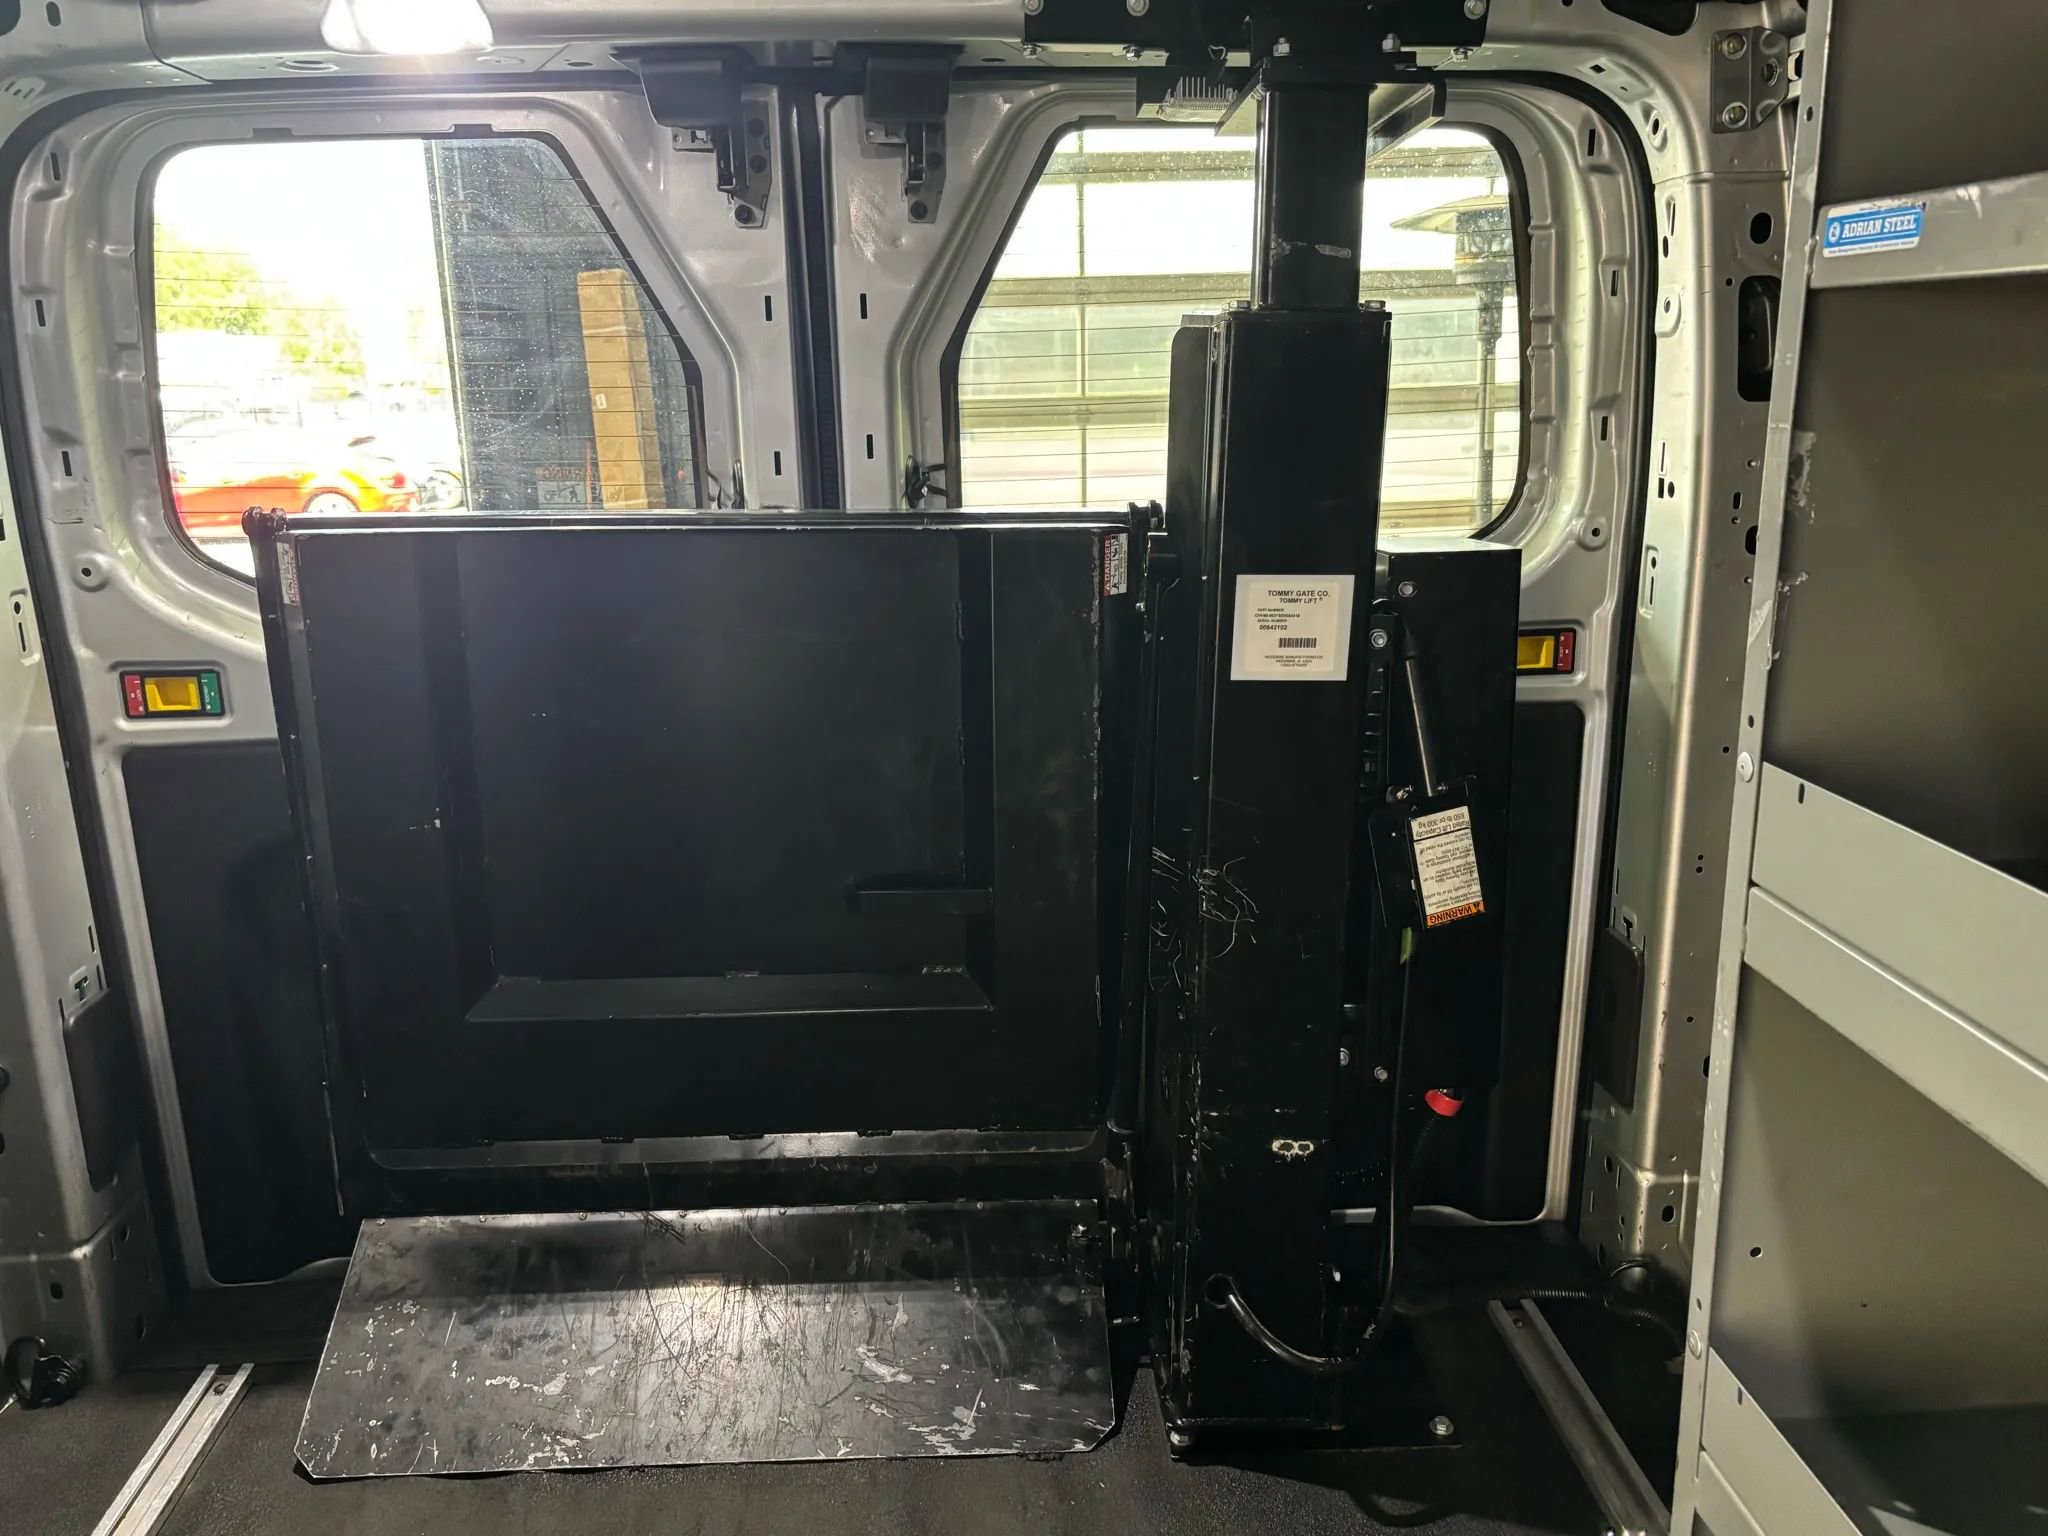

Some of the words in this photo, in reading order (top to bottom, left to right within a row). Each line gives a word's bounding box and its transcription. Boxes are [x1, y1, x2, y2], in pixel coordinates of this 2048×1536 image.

[1842, 219, 1882, 238] ADRIAN
[1883, 214, 1918, 232] STEEL
[1415, 826, 1441, 839] Capacity
[1452, 820, 1469, 829] Rated
[1430, 905, 1472, 924] WARNING
